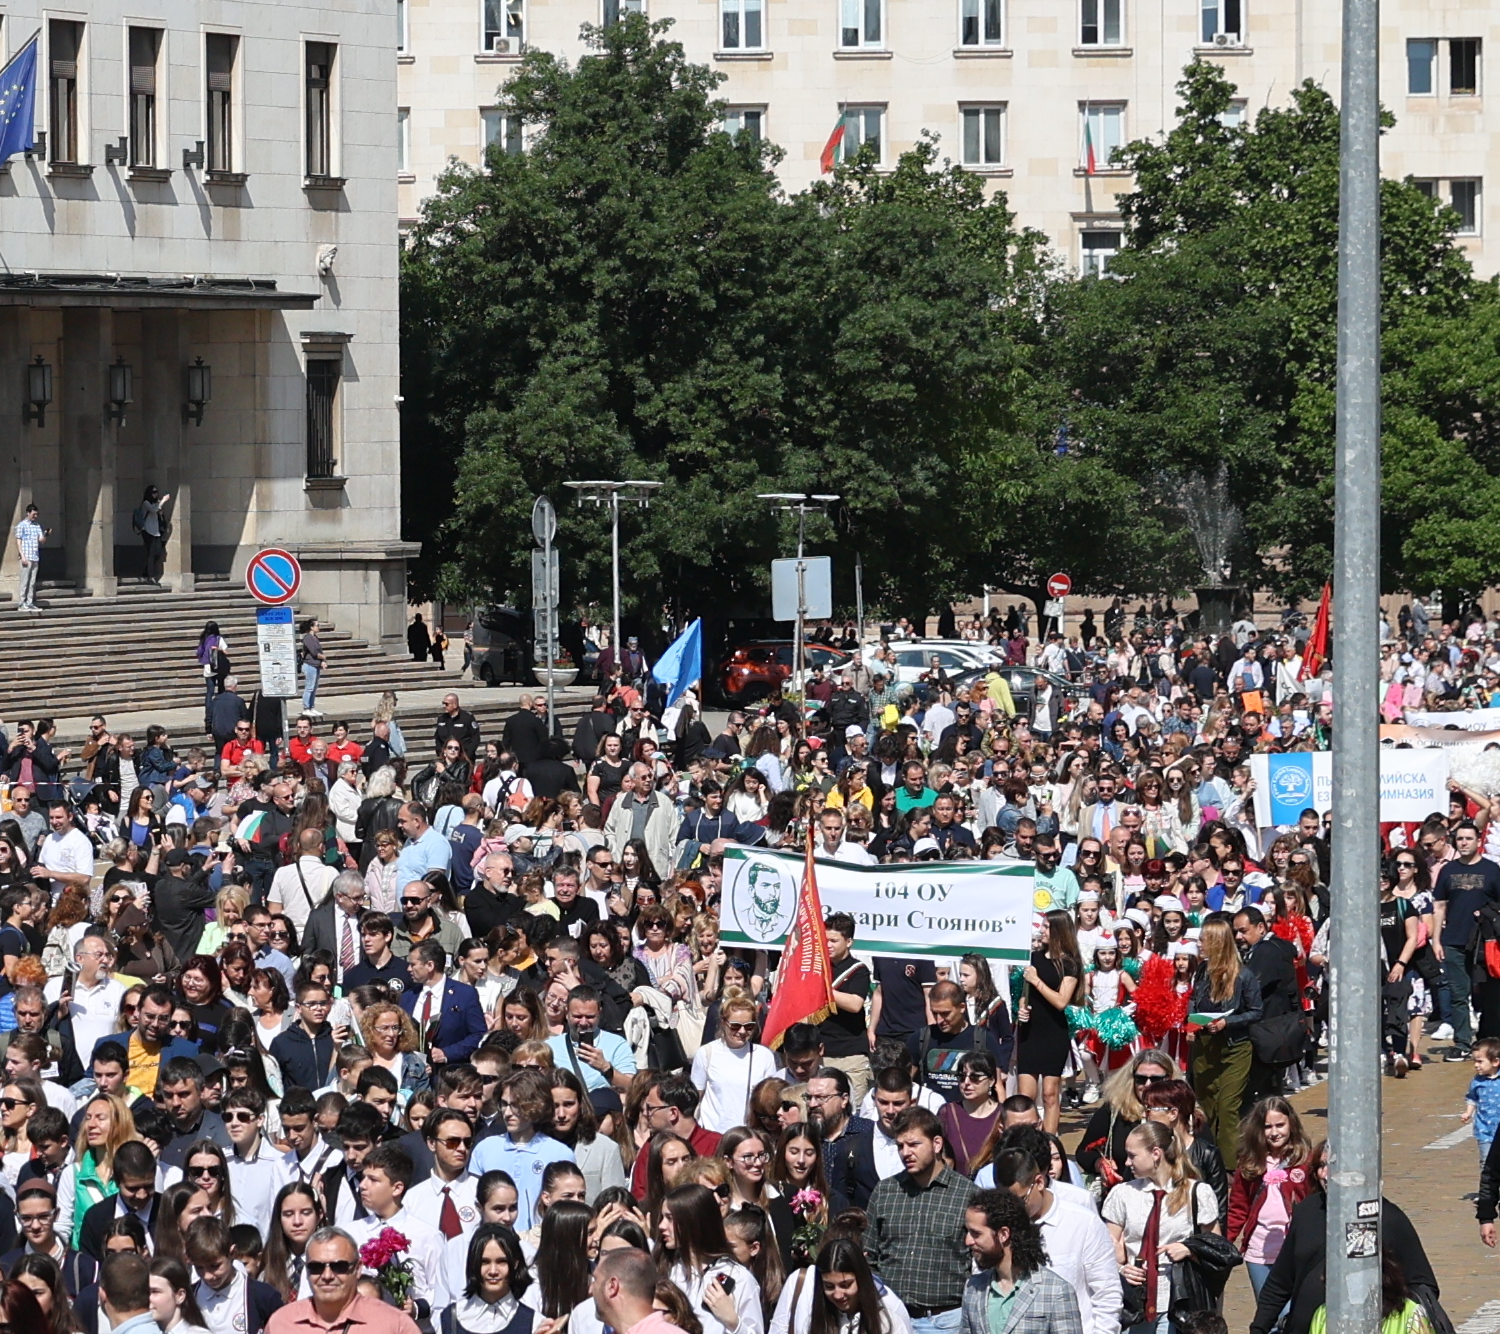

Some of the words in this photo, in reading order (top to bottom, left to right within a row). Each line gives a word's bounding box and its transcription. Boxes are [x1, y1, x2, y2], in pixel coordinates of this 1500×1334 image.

[1380, 771, 1427, 784] ЛИЙСКА
[1379, 788, 1434, 800] ИМНАЗИЯ
[873, 881, 909, 900] 104
[917, 883, 954, 902] ОУ
[907, 910, 1017, 934] Стоянов“
